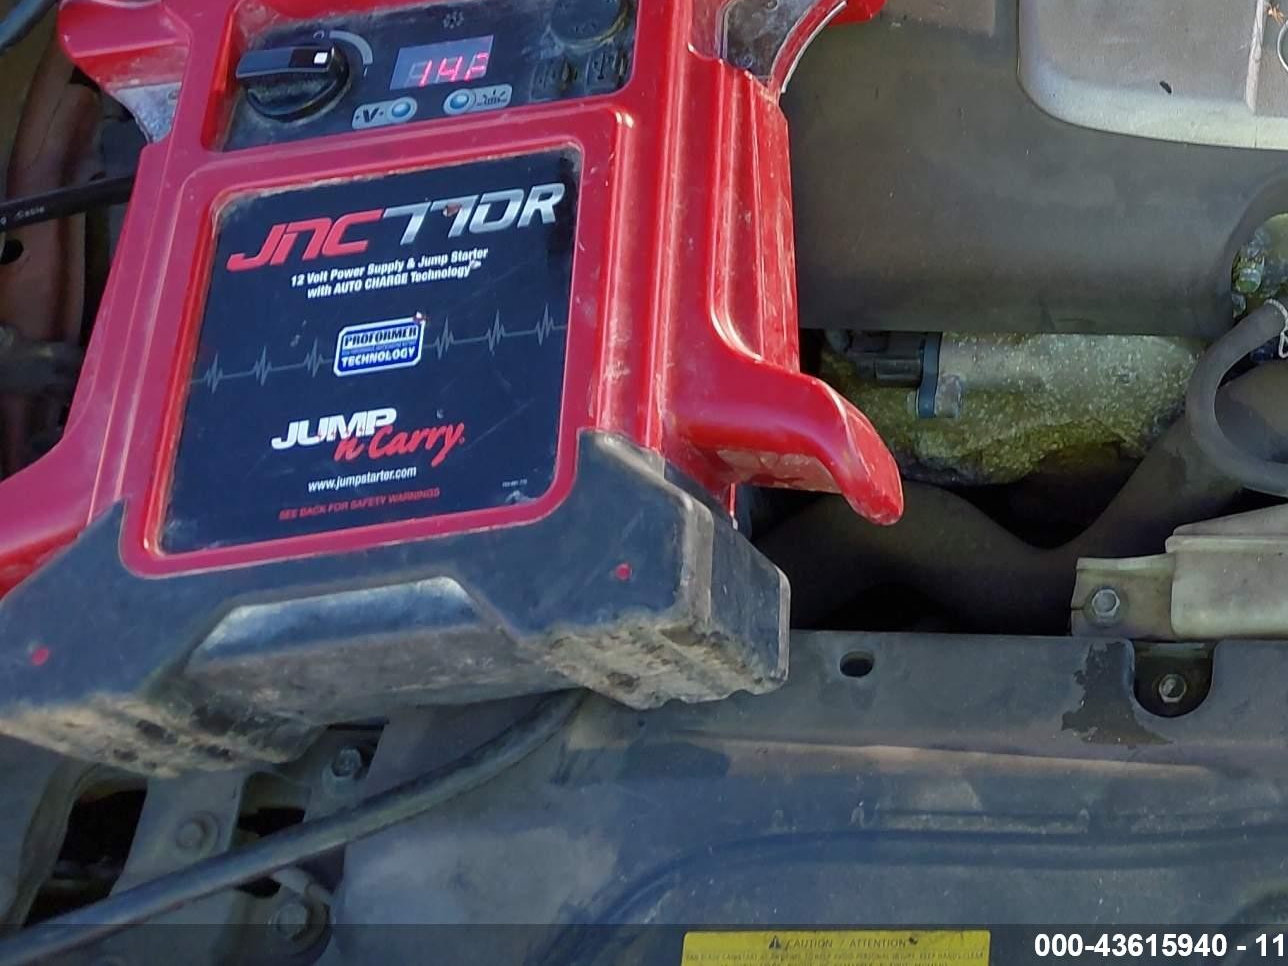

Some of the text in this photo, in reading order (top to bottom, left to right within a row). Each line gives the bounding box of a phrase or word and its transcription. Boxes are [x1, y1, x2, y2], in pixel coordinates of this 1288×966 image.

[225, 183, 566, 272] JNC770R
[290, 247, 489, 287] 12 Volt Power Supply & Jump Starter
[307, 285, 332, 299] with
[333, 281, 362, 296] AUTO
[364, 275, 408, 291] CHARGE
[344, 324, 419, 347] PROFORMER
[340, 346, 416, 368] TECHNOLOGY
[271, 407, 398, 450] JUMP
[307, 466, 417, 492] www.jumpstarter.com
[299, 504, 327, 518] BACK
[328, 501, 349, 513] FOR
[350, 494, 388, 511] SAFETY
[388, 487, 441, 505] WARNINGS
[786, 937, 833, 948] CAUTION
[848, 937, 906, 948] ATTENTION
